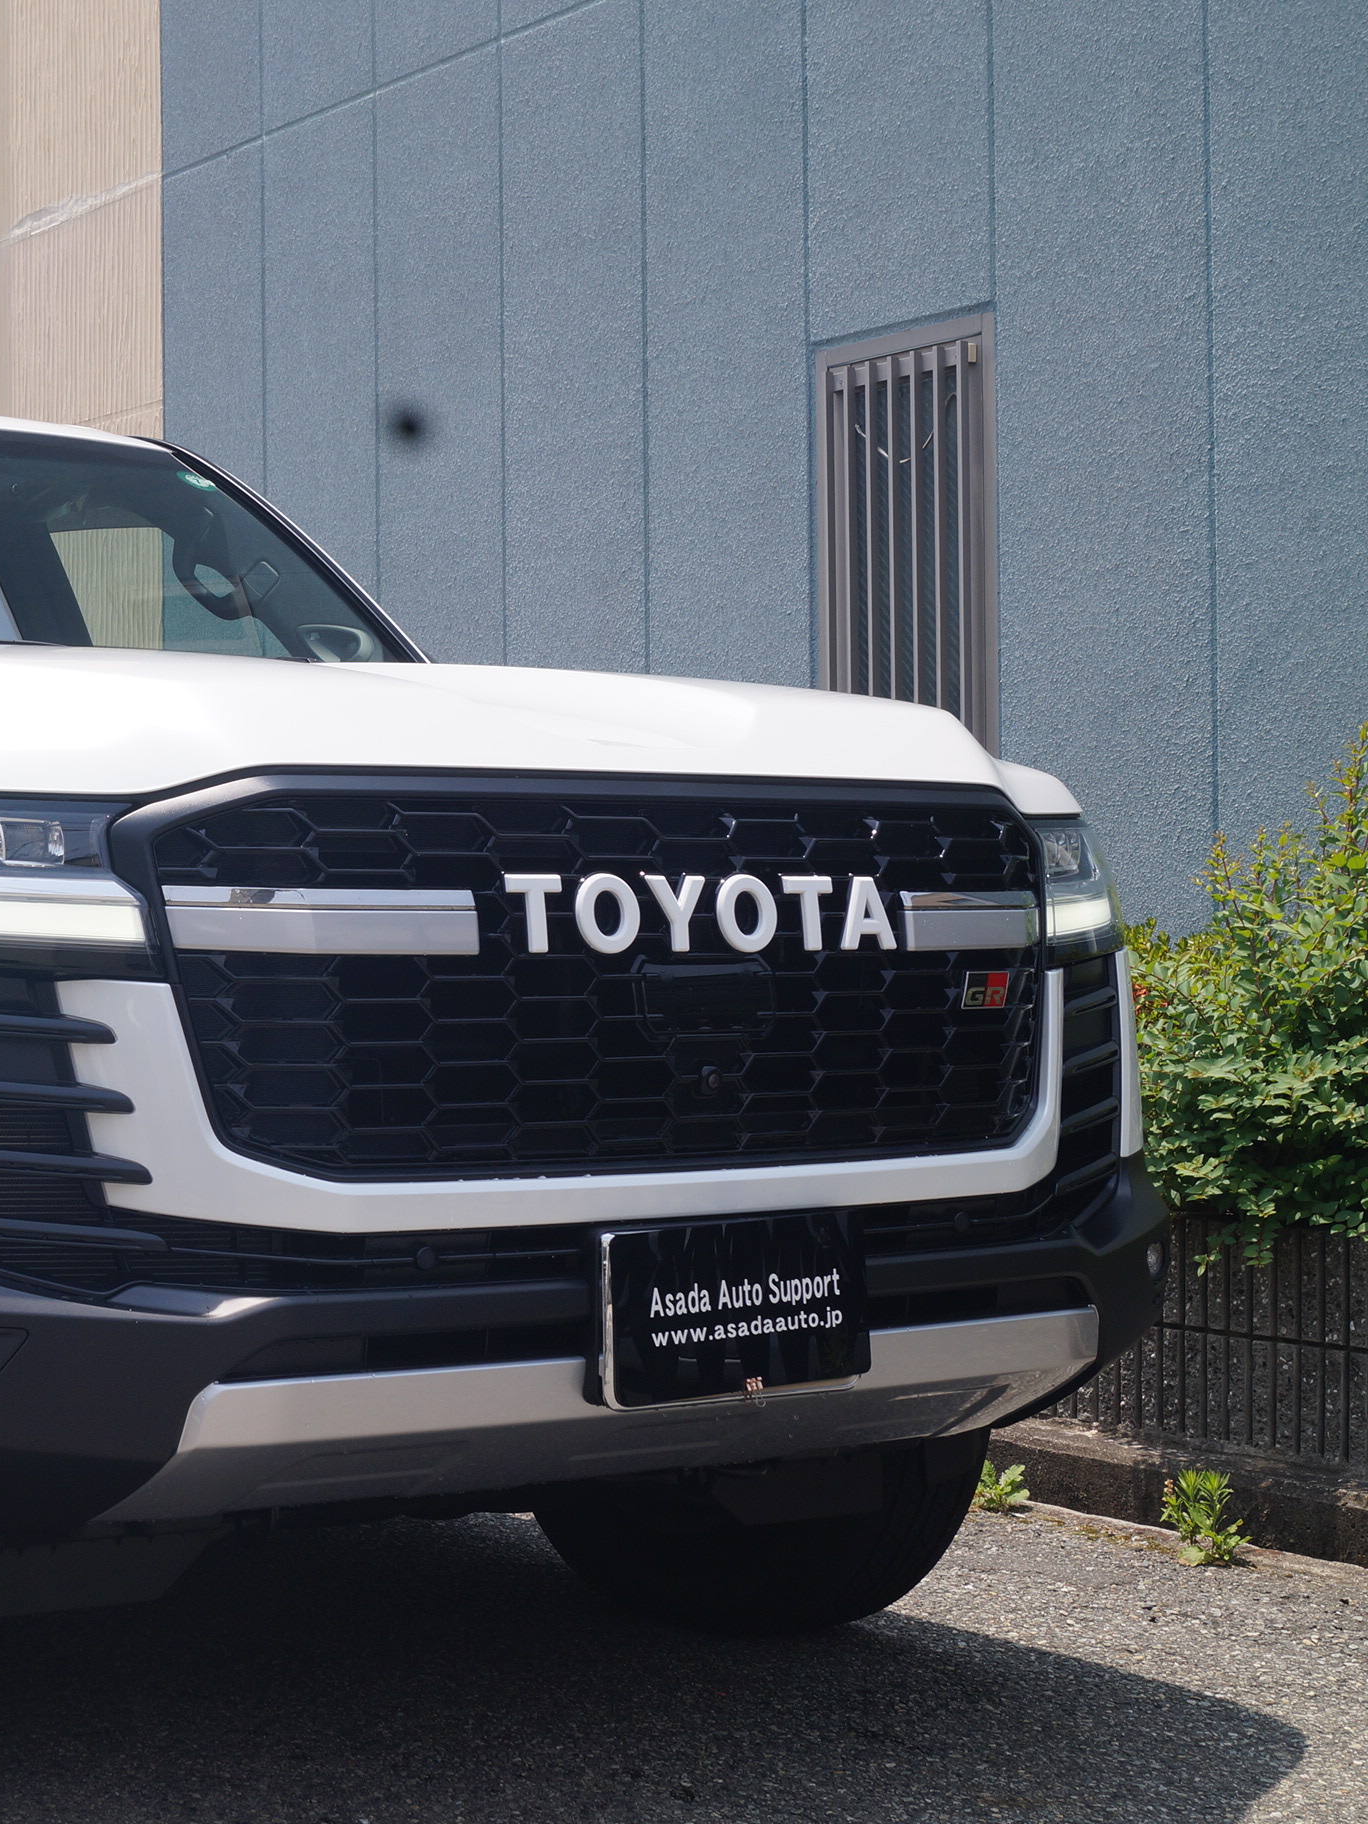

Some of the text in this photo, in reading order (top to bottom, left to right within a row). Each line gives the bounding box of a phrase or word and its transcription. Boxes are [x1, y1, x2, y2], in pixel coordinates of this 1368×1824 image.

[502, 872, 898, 955] TOYOTA
[965, 986, 1005, 1006] GR
[649, 1268, 841, 1319] Asada Auto Support
[650, 1306, 844, 1348] www.asadaauto.jp
